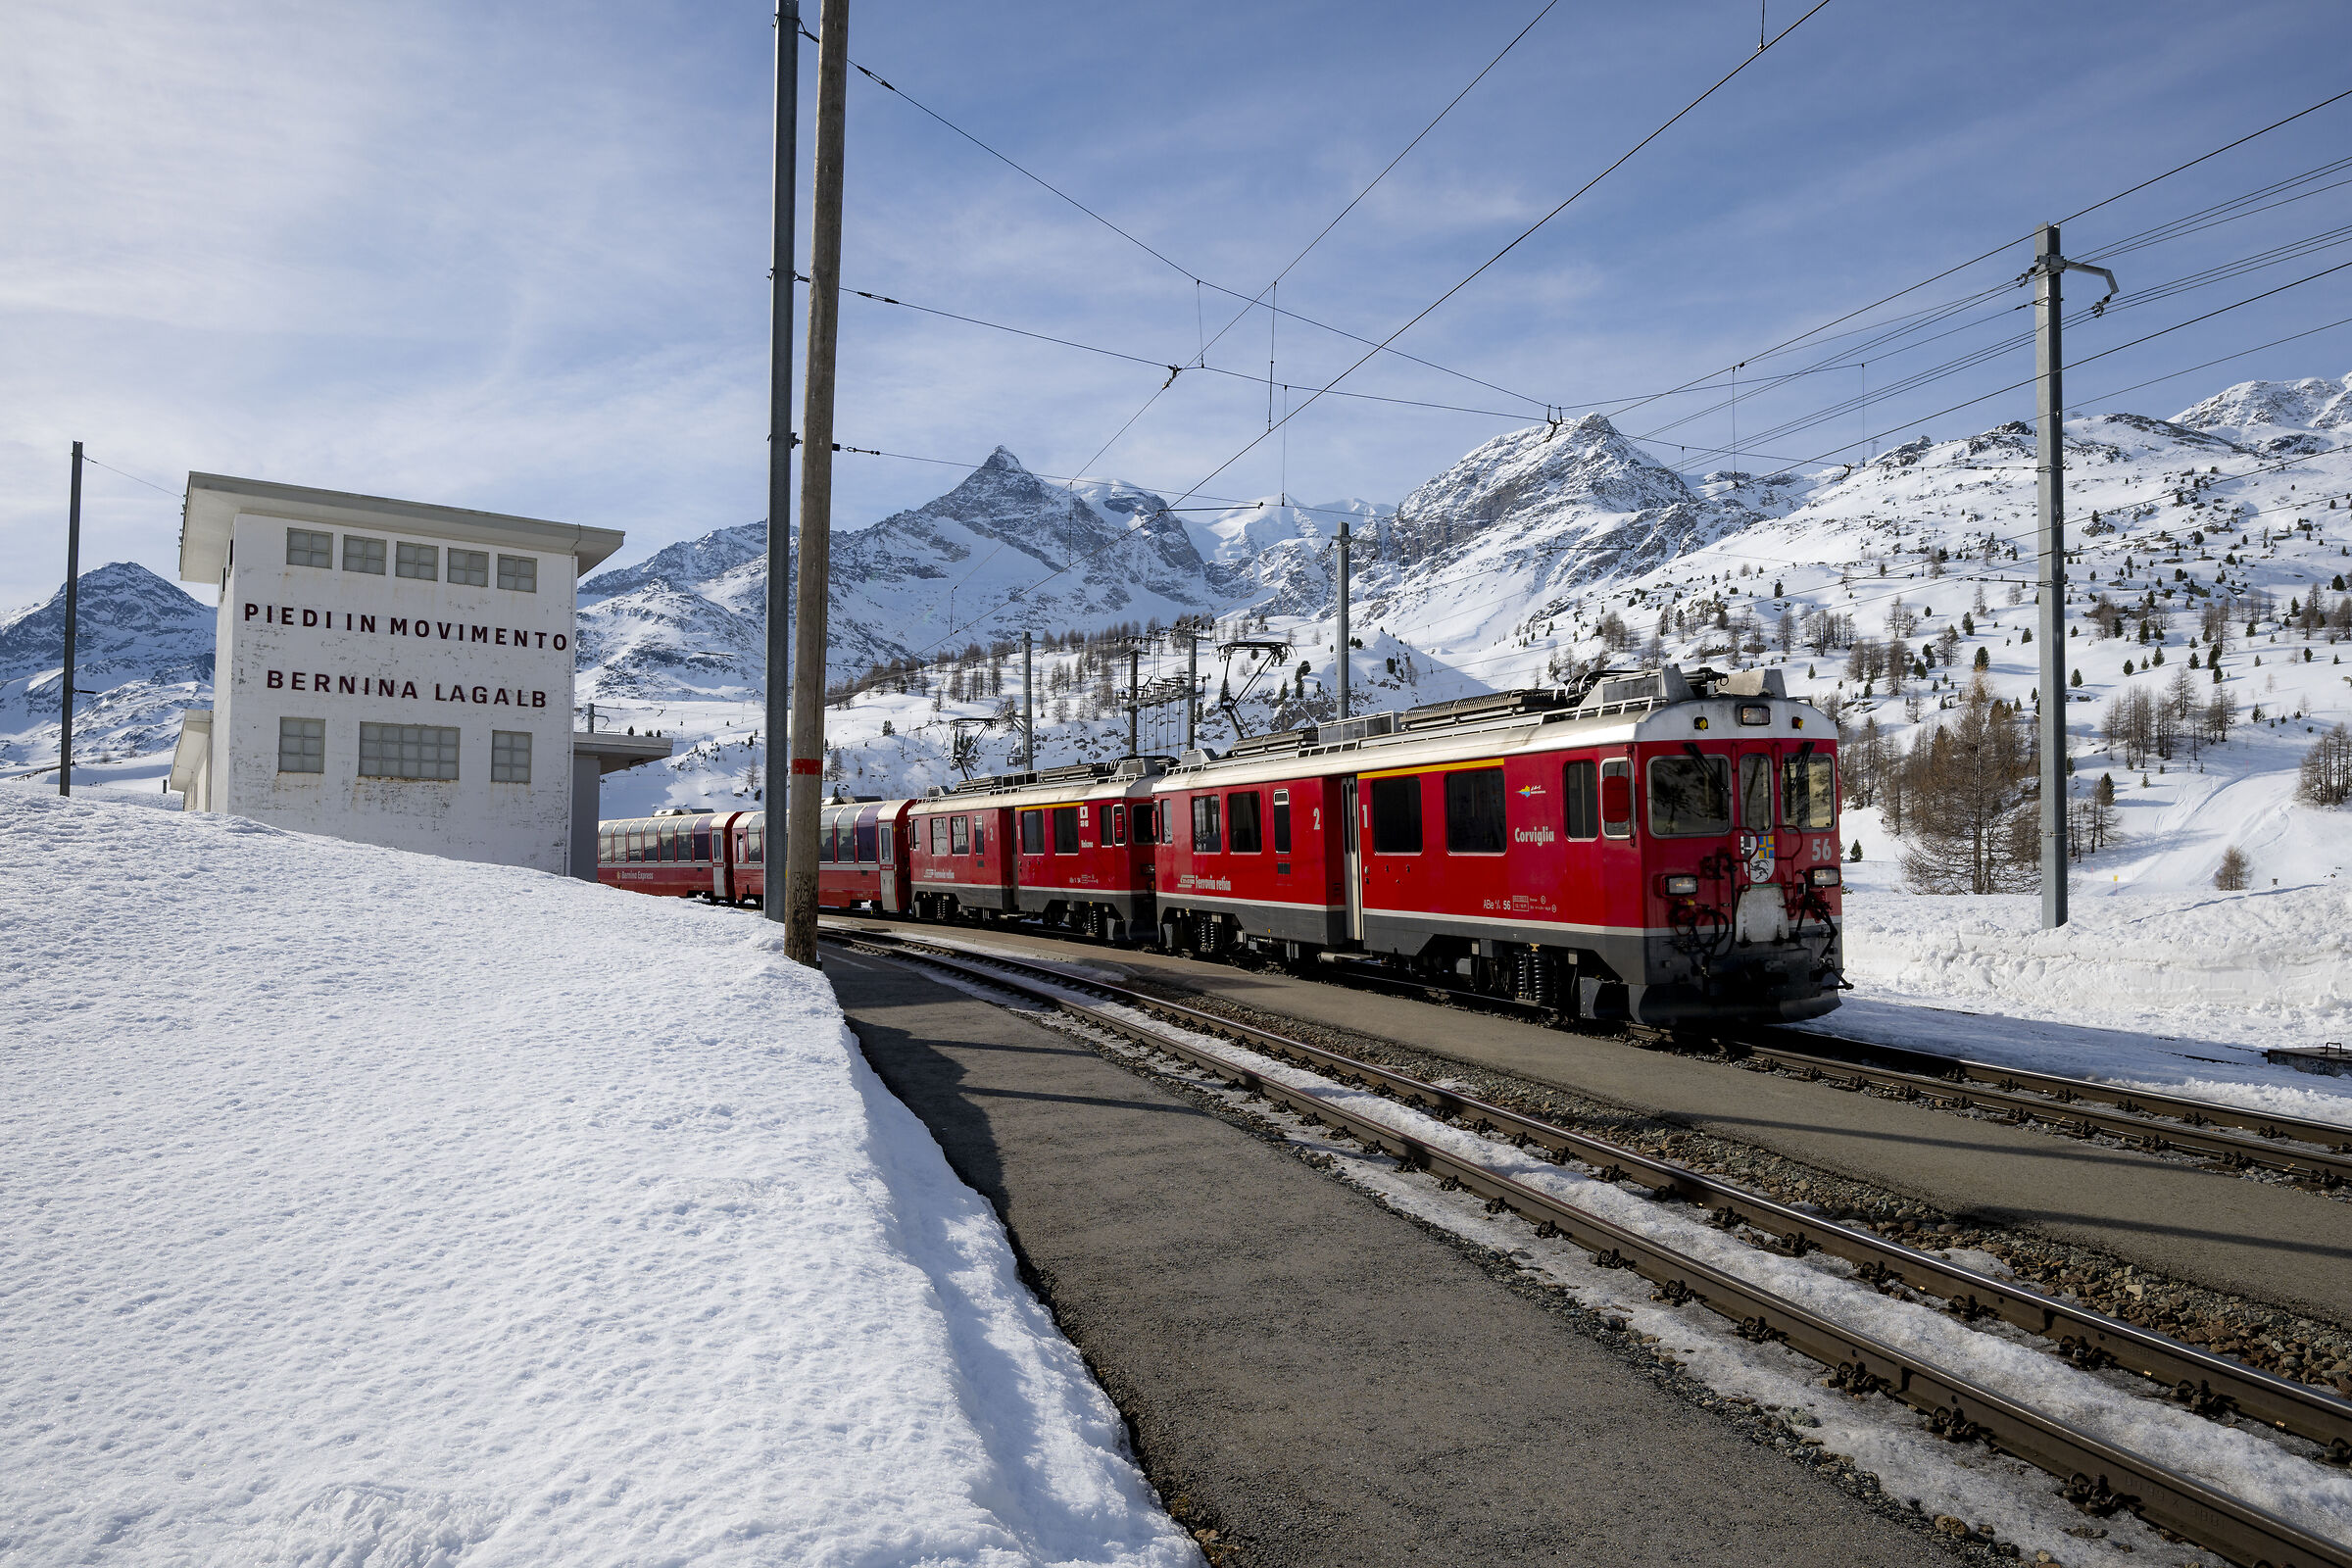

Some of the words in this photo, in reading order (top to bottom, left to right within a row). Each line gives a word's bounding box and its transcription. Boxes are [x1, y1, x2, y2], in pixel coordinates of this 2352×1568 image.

[244, 603, 332, 630] PIEDI
[346, 612, 376, 634] IN
[390, 617, 568, 652] MOVIMENTO
[267, 669, 418, 700] BERNINA
[434, 683, 547, 709] LAGALB
[1313, 808, 1321, 830] 2
[1362, 805, 1368, 828] 1
[989, 827, 994, 841] 2
[1515, 825, 1555, 847] Corviglia
[1812, 838, 1832, 861] 56
[621, 870, 637, 879] Bernina
[637, 870, 654, 881] Express
[1502, 900, 1511, 910] 56
